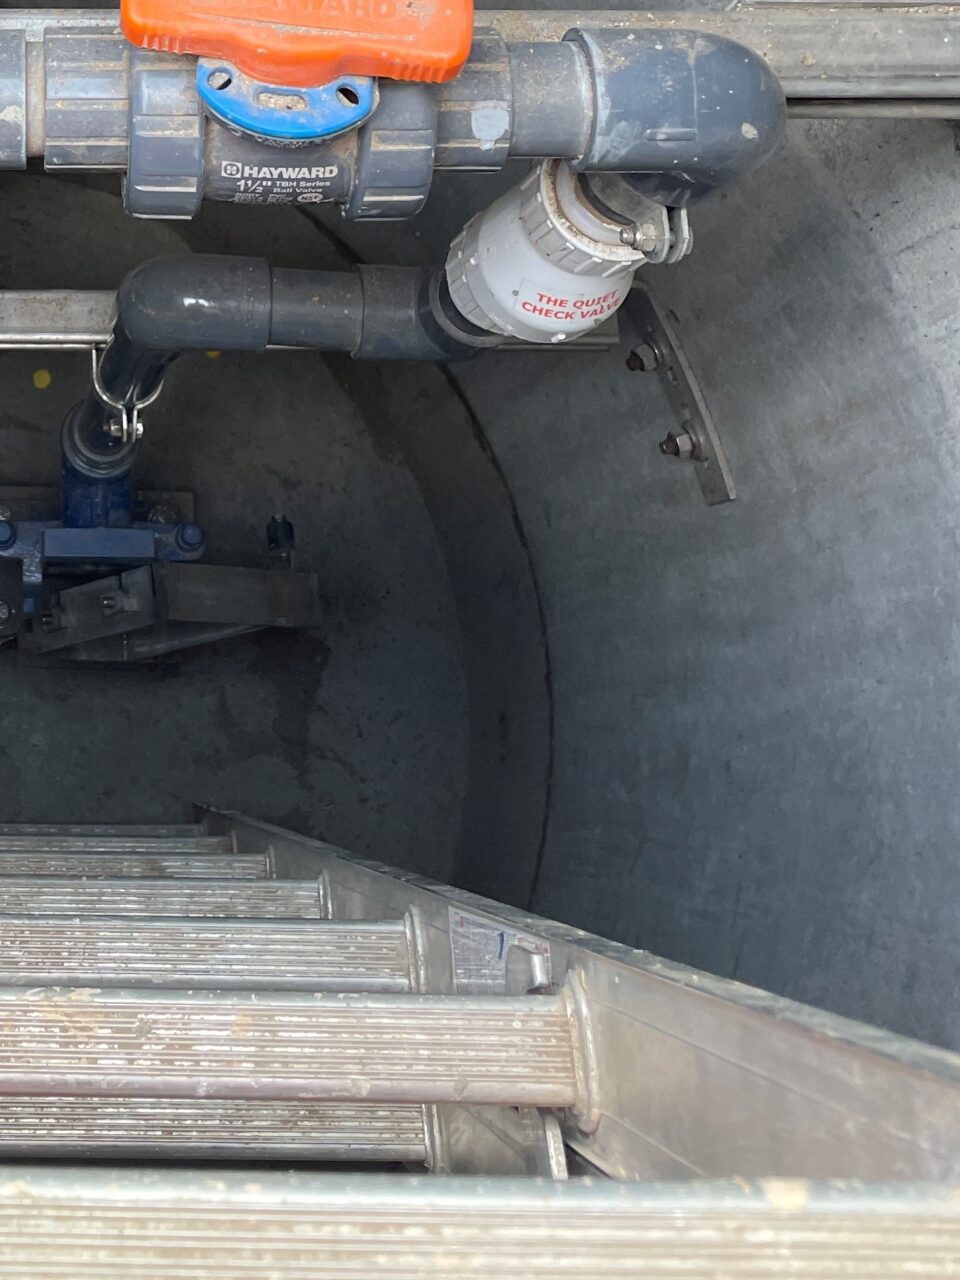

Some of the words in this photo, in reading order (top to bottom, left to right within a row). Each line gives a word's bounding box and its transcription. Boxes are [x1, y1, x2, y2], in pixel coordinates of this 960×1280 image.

[244, 166, 338, 178] HAYWARD
[521, 302, 575, 319] CHECK
[580, 298, 620, 319] VALVE
[537, 293, 568, 308] THE
[573, 289, 617, 309] QUIET
